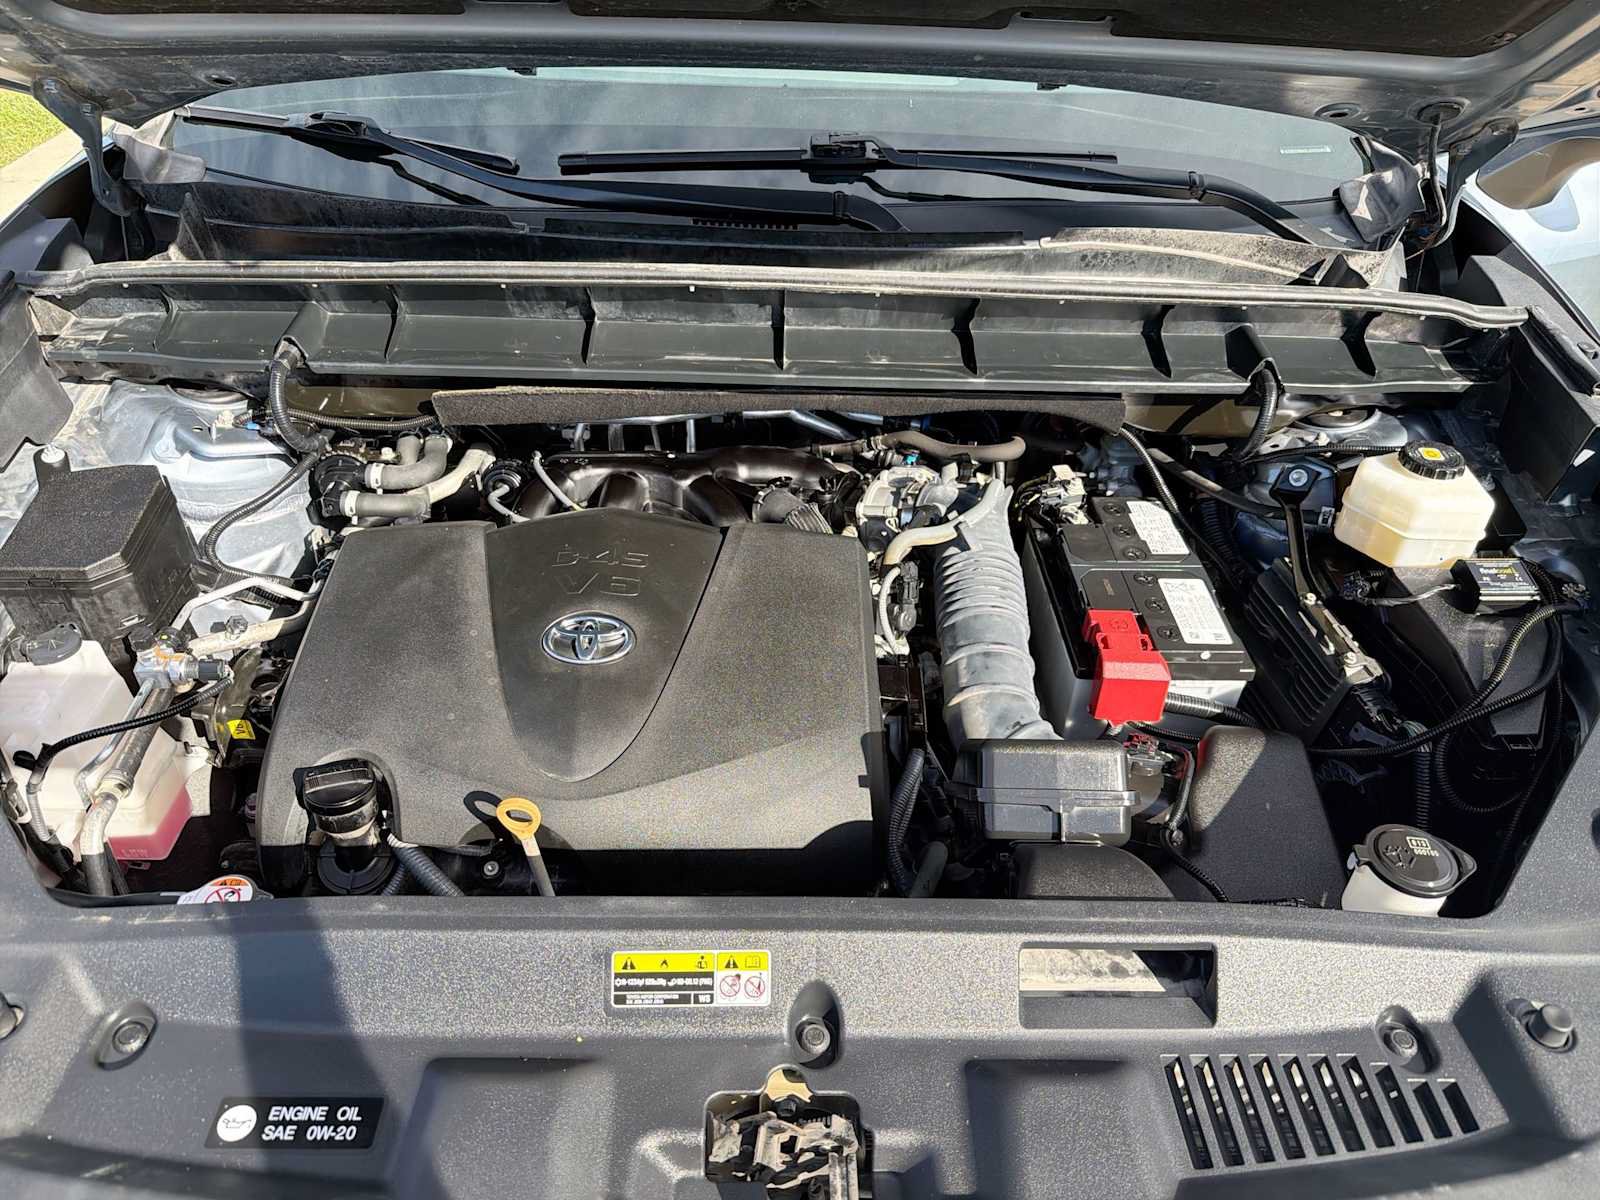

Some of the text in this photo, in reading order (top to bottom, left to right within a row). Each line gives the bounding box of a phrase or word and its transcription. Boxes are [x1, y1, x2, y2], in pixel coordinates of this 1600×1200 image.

[268, 1106, 362, 1121] ENGINE OIL
[261, 1125, 357, 1141] SAE 0W-20
